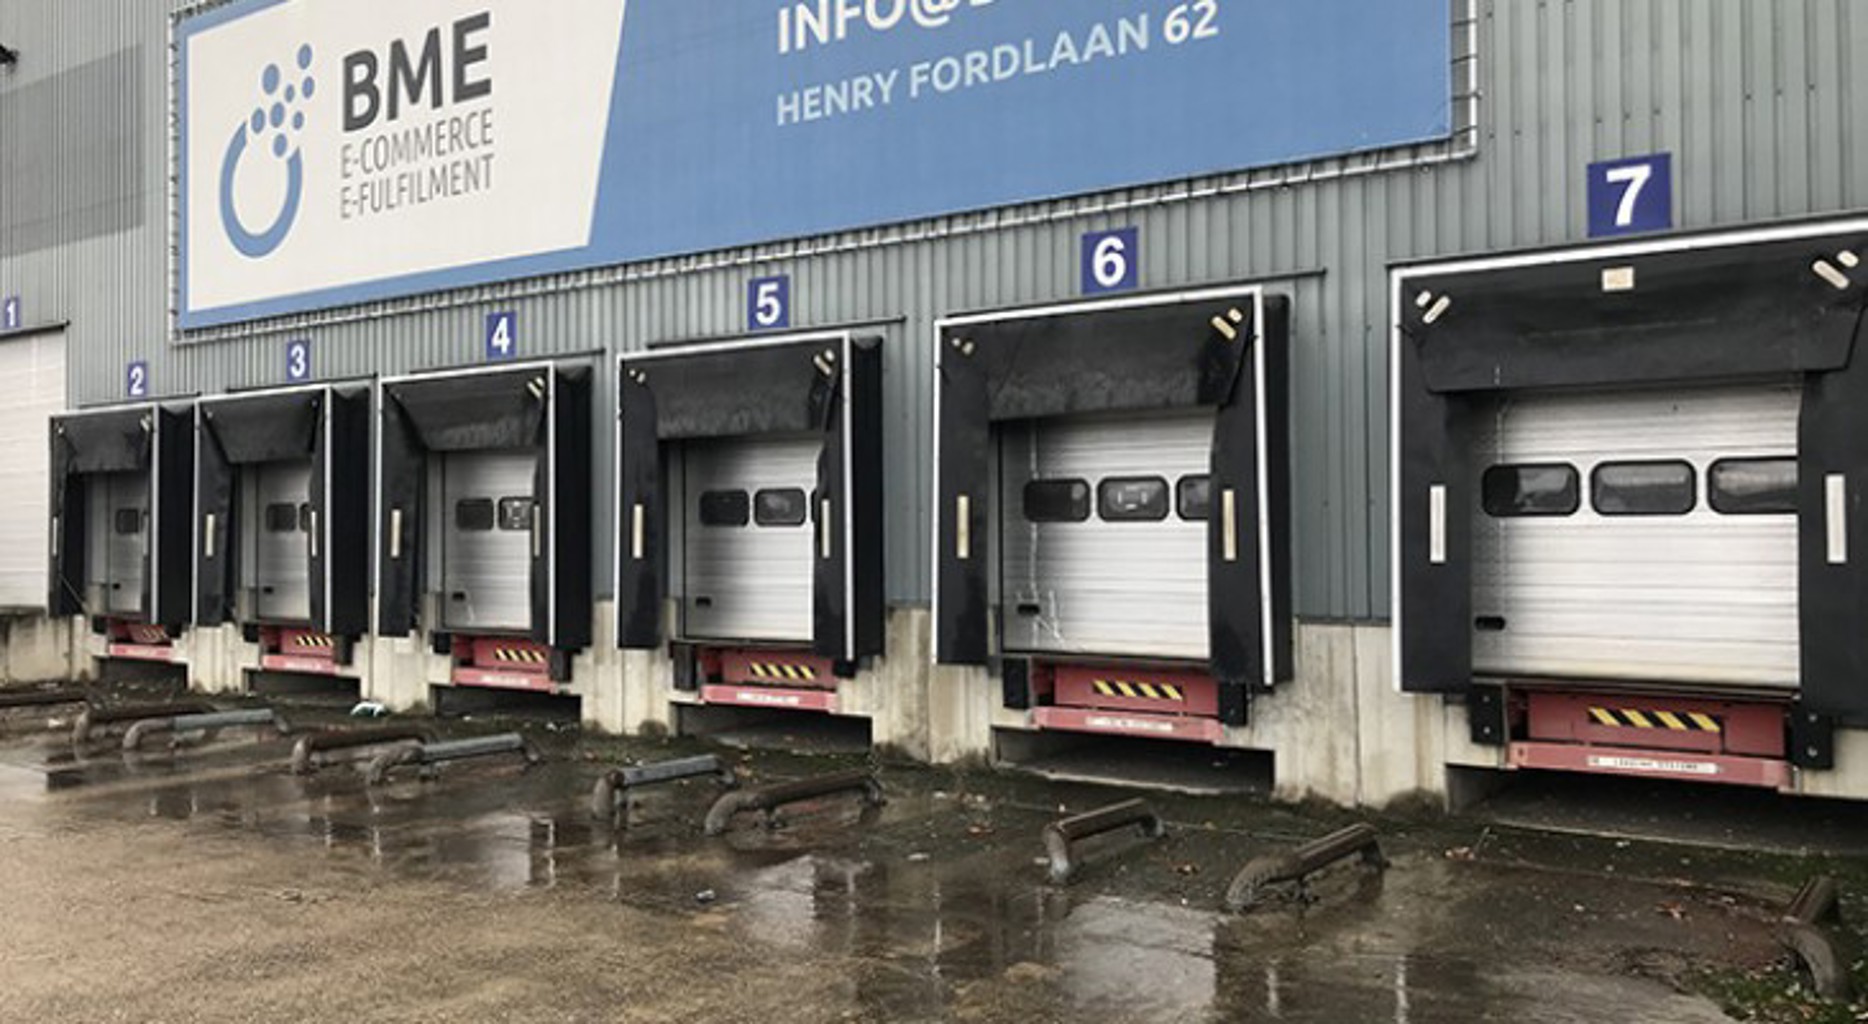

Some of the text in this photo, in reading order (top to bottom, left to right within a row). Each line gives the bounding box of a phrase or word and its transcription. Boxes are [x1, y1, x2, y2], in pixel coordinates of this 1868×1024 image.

[778, 0, 994, 53] INFO@
[343, 11, 492, 131] BME
[776, 0, 1219, 126] HENRY FORDLAAN 62
[341, 109, 493, 178] E-COMMERCE
[341, 154, 494, 218] E-FULFILMENT
[1606, 166, 1652, 226] 7
[1092, 237, 1126, 286] 6
[6, 303, 16, 326] 1
[756, 282, 781, 325] 5
[491, 317, 510, 353] 4
[130, 366, 143, 394] 2
[290, 345, 305, 378] 3
